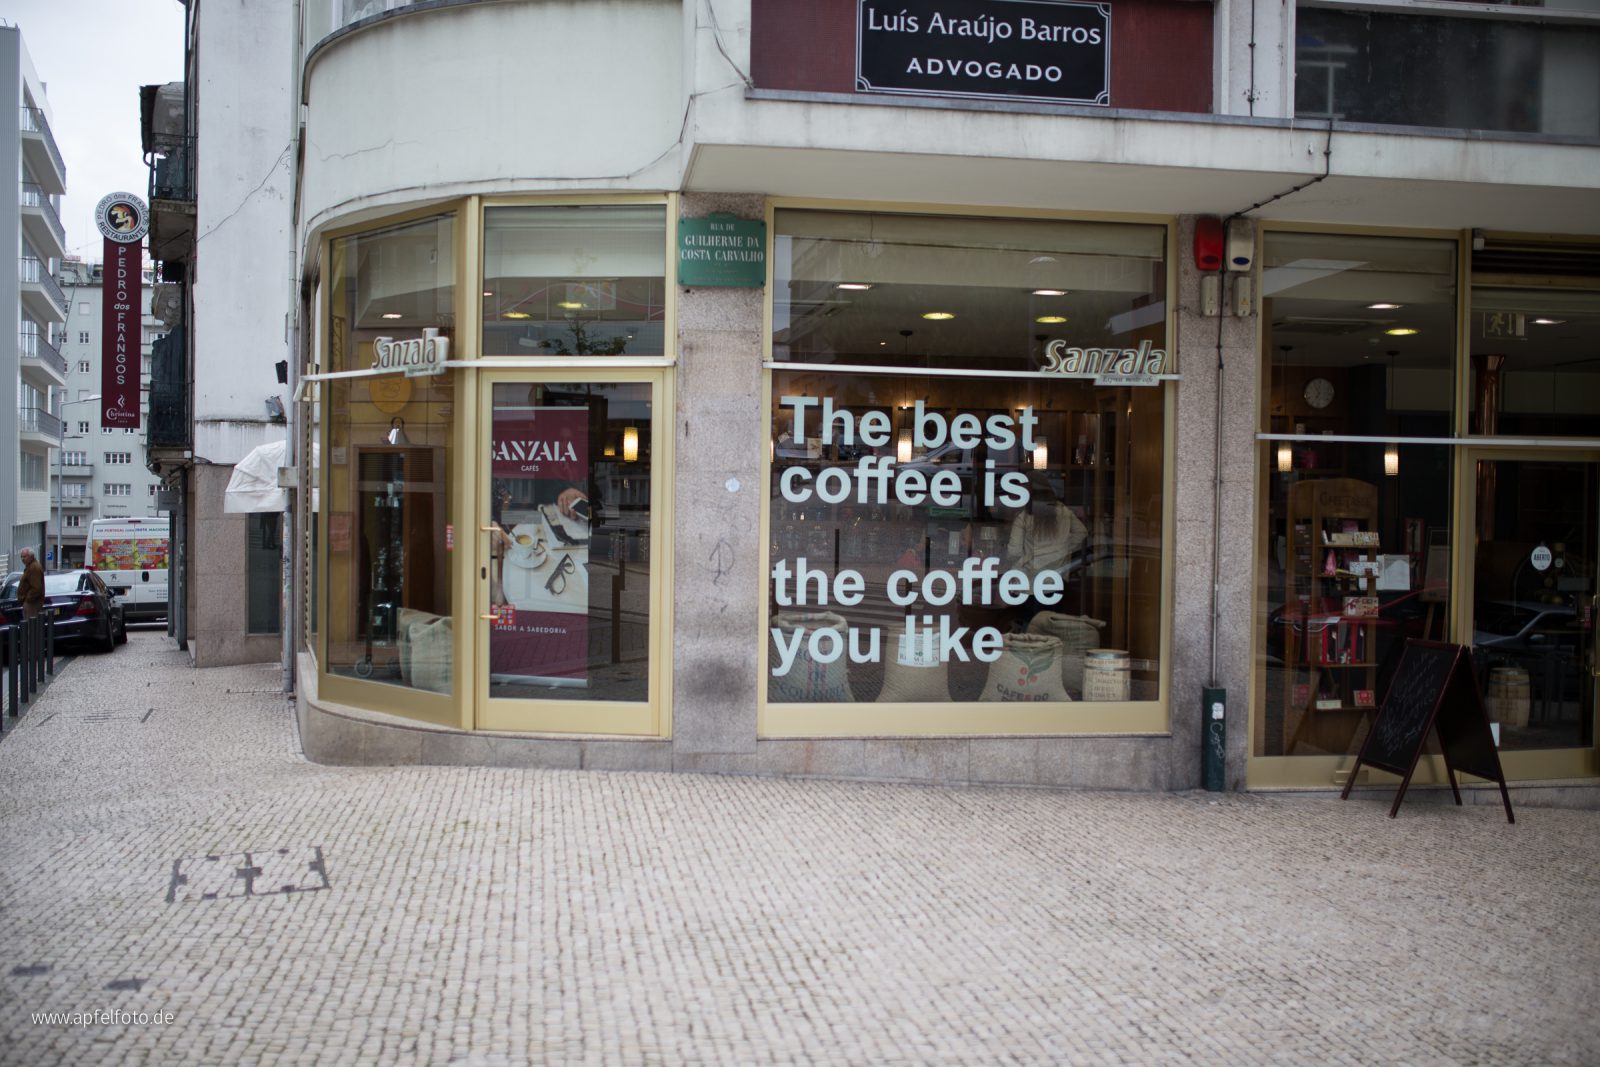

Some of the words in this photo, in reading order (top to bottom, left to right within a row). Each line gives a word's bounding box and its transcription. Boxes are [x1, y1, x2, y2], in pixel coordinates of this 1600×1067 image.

[868, 8, 919, 33] Luís
[927, 12, 1012, 43] Araújo
[1021, 18, 1101, 45] Barros
[906, 57, 1062, 82] ADVOGADO
[98, 221, 146, 241] RESTAURANTE
[685, 234, 743, 247] GUILHERME
[747, 236, 759, 248] DA
[710, 223, 724, 231] RUA
[726, 223, 735, 231] DE
[116, 246, 127, 301] PEDRO
[681, 249, 711, 260] COSTA
[715, 250, 764, 262] CARVALHO
[114, 302, 131, 310] dos
[116, 313, 127, 385] FRANGOS
[372, 329, 438, 369] Sanzala
[1042, 339, 1167, 375] Sanzala
[780, 395, 892, 447] The
[914, 400, 1038, 451] best
[780, 455, 962, 506] coffee
[984, 459, 1031, 508] is
[771, 557, 865, 606] the
[887, 557, 1064, 606] coffee
[527, 626, 567, 634] SABEDORIA
[770, 625, 881, 677] you
[905, 615, 1004, 663] like
